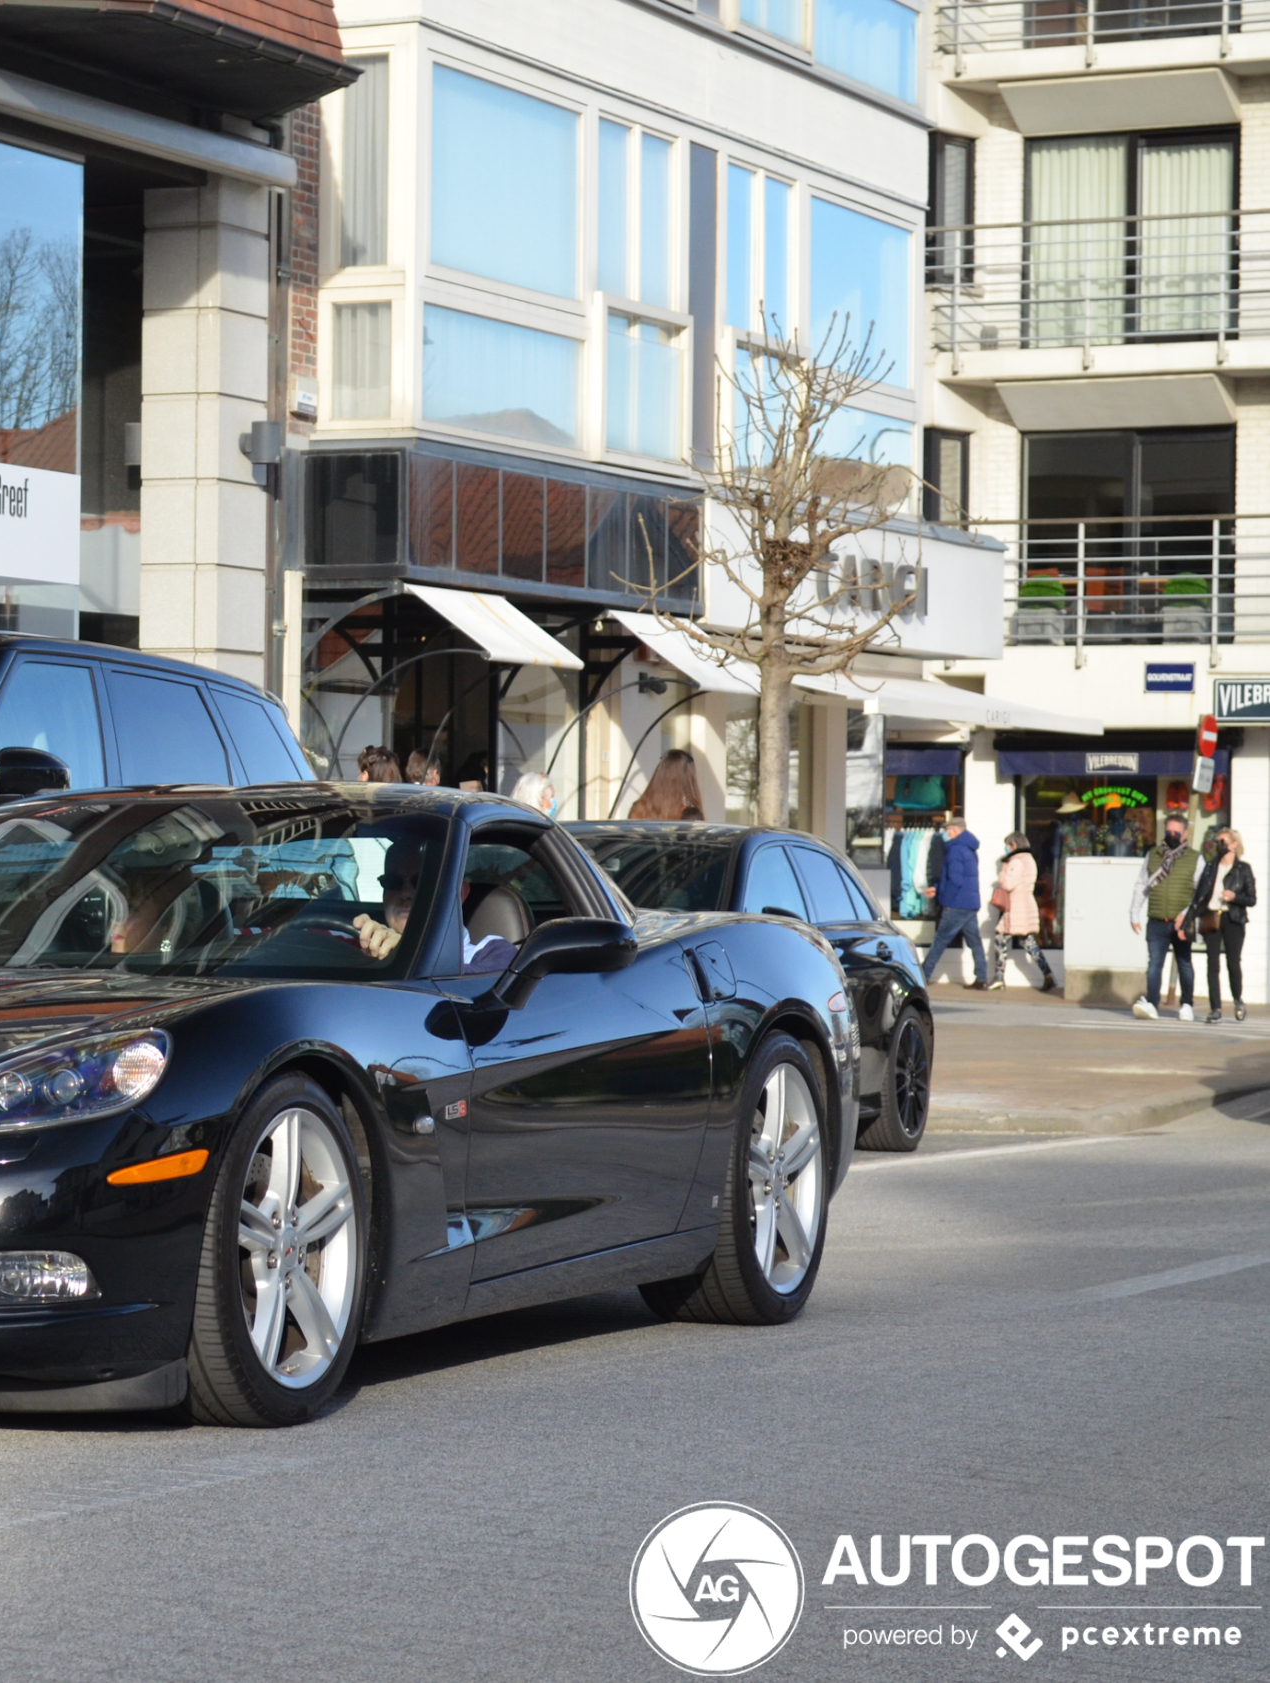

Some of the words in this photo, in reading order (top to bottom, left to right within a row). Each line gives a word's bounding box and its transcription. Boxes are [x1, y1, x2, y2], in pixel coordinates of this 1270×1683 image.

[986, 709, 1011, 724] CARIGI
[1087, 754, 1137, 771] VILEBREQUIN
[447, 1100, 467, 1117] LS3
